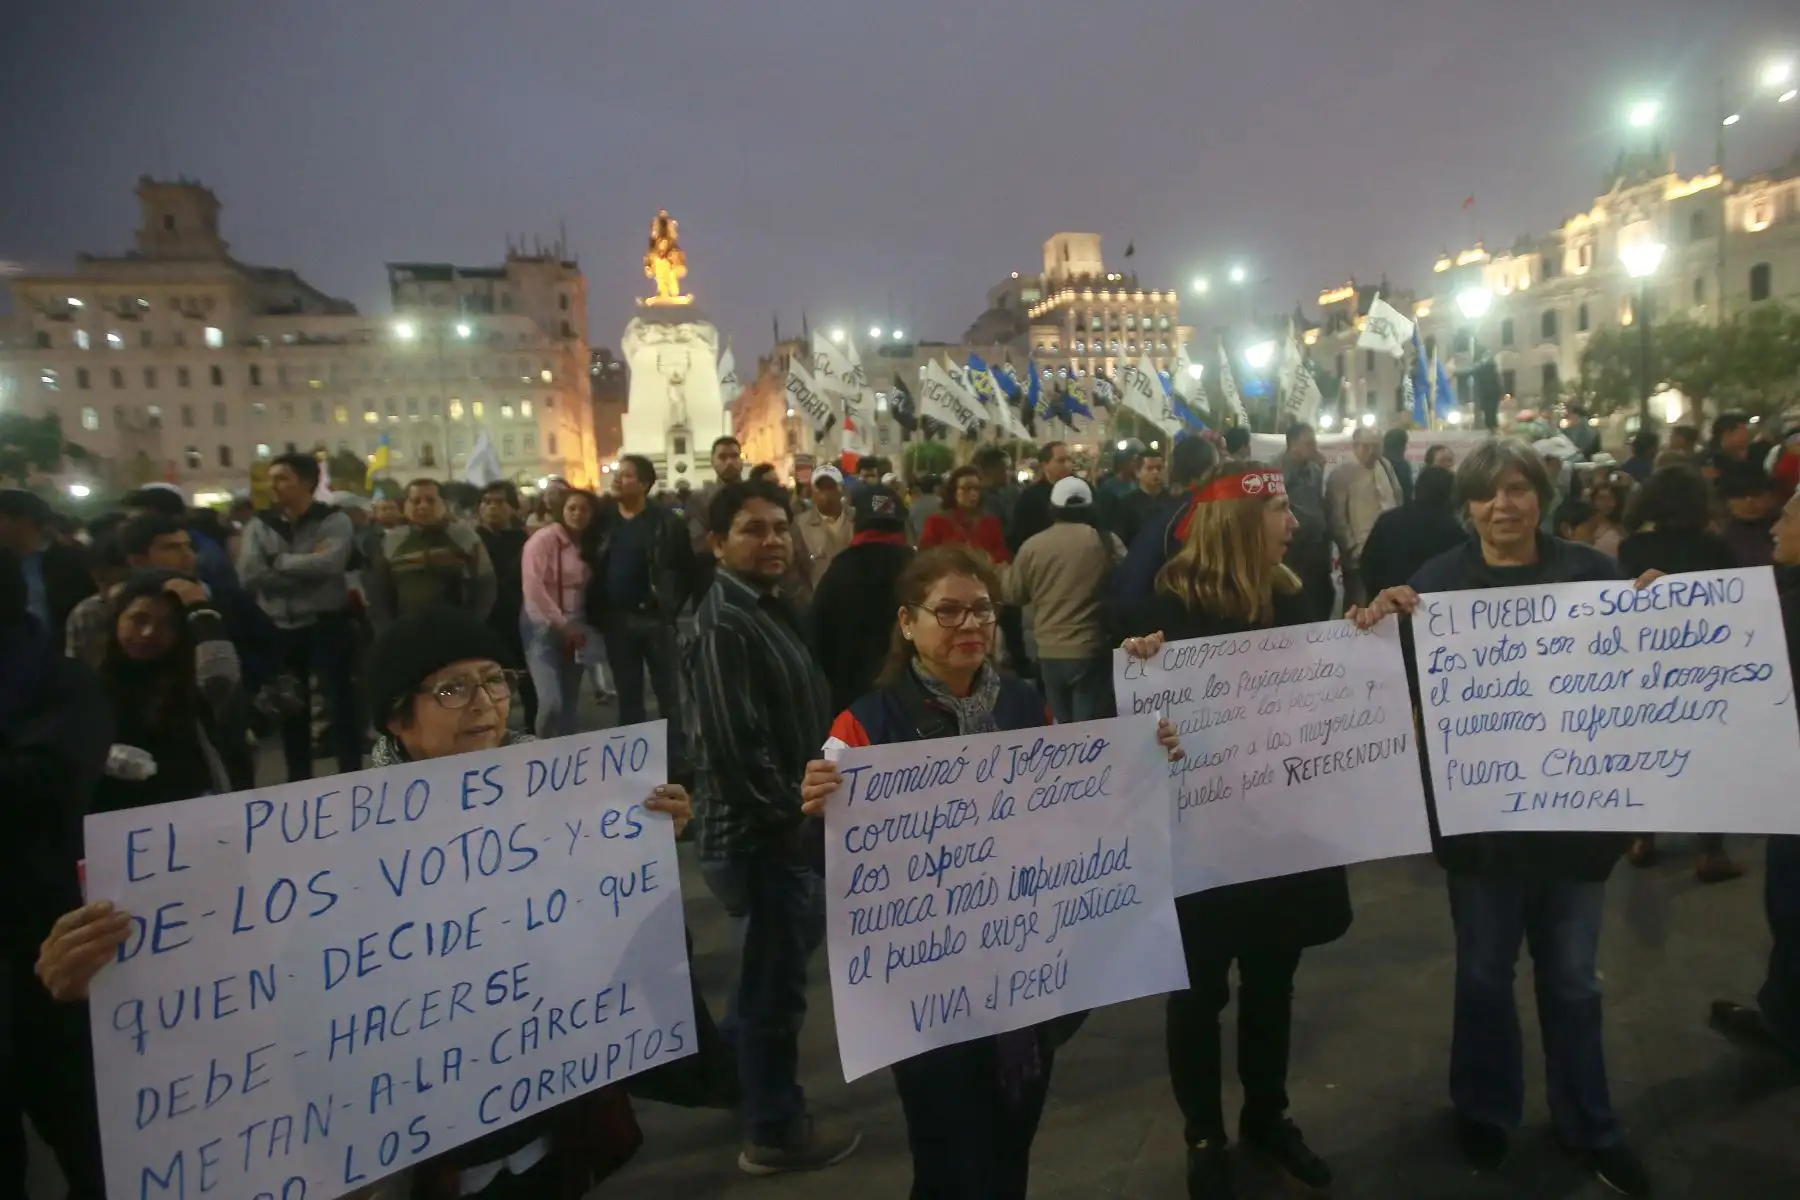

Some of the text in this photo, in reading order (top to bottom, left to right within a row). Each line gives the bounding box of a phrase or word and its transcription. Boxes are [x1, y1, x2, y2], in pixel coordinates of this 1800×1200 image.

[1471, 593, 1556, 630] PUEBLO
[1600, 577, 1745, 616] SOBERANO
[1162, 637, 1251, 672] congreso
[1476, 636, 1527, 667] votos
[1536, 635, 1573, 656] son
[1588, 627, 1629, 656] del
[1203, 672, 1231, 697] los
[1431, 681, 1450, 707] el
[1462, 671, 1533, 700] decide
[1550, 668, 1634, 694] cerrar
[1663, 662, 1774, 692] congreso
[1266, 729, 1293, 750] las
[1438, 709, 1547, 755] queremos
[842, 746, 970, 807] Terminó
[976, 745, 1000, 783] el
[988, 789, 1016, 823] la
[1027, 766, 1111, 813] cárcel
[1177, 733, 1407, 822] pueblo pide REFERENDUN
[1500, 788, 1644, 813] INMORAL
[127, 735, 648, 883] EL PUEBLO ES DUEÑO
[118, 901, 192, 963] DE
[233, 869, 338, 934] LOS
[379, 823, 538, 897] VOTOS
[845, 836, 999, 899] los espera
[849, 836, 1133, 937] nunca más impunidad
[324, 906, 486, 990] DECIDE
[526, 888, 566, 931] LO
[848, 946, 873, 986] el
[885, 930, 968, 985] pueblo
[980, 912, 1038, 953] exige
[910, 986, 971, 1033] VIVA
[1009, 951, 1068, 1007] PERÚ
[141, 981, 636, 1200] METAN A LA CÁRCEL
[345, 1019, 685, 1183] LOS CORRUPTOS
